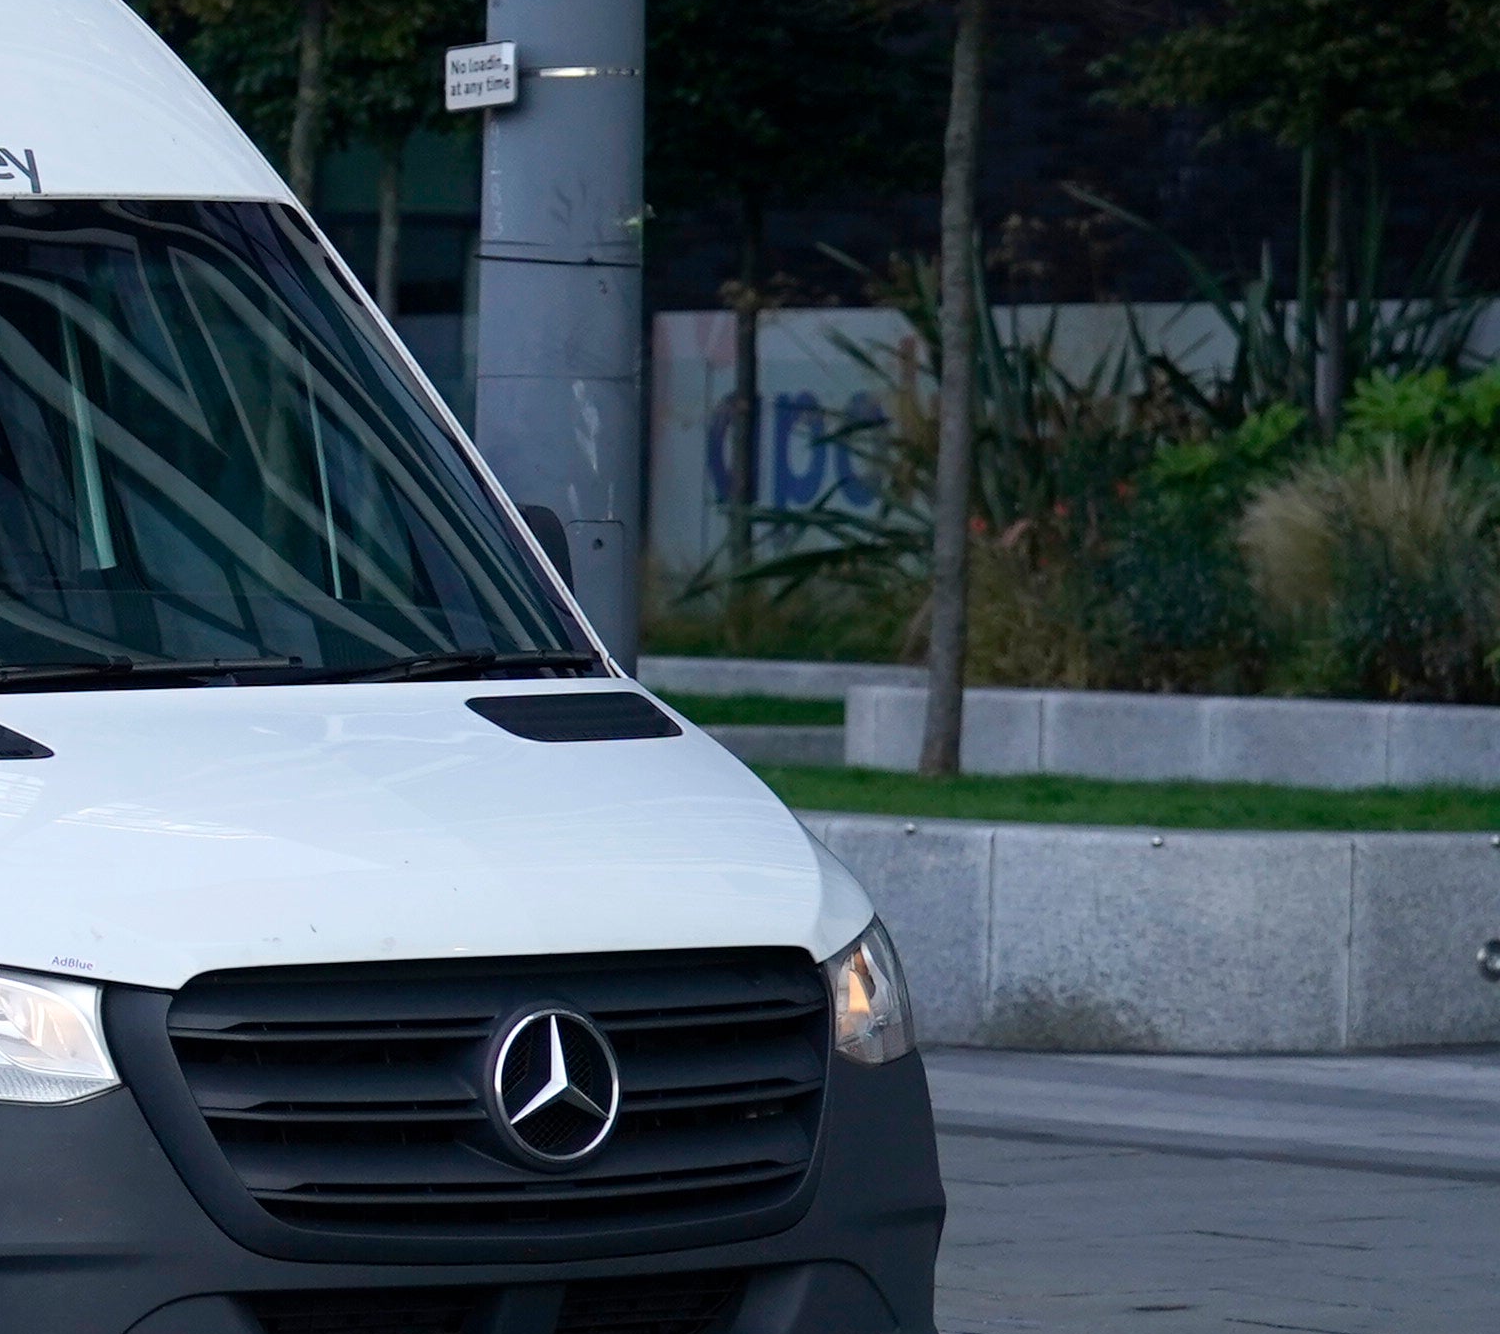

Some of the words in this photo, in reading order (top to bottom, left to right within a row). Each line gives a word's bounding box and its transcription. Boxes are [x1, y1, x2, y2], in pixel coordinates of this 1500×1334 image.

[450, 59, 466, 75] No
[450, 81, 462, 97] at
[464, 81, 483, 96] any
[486, 75, 511, 92] time
